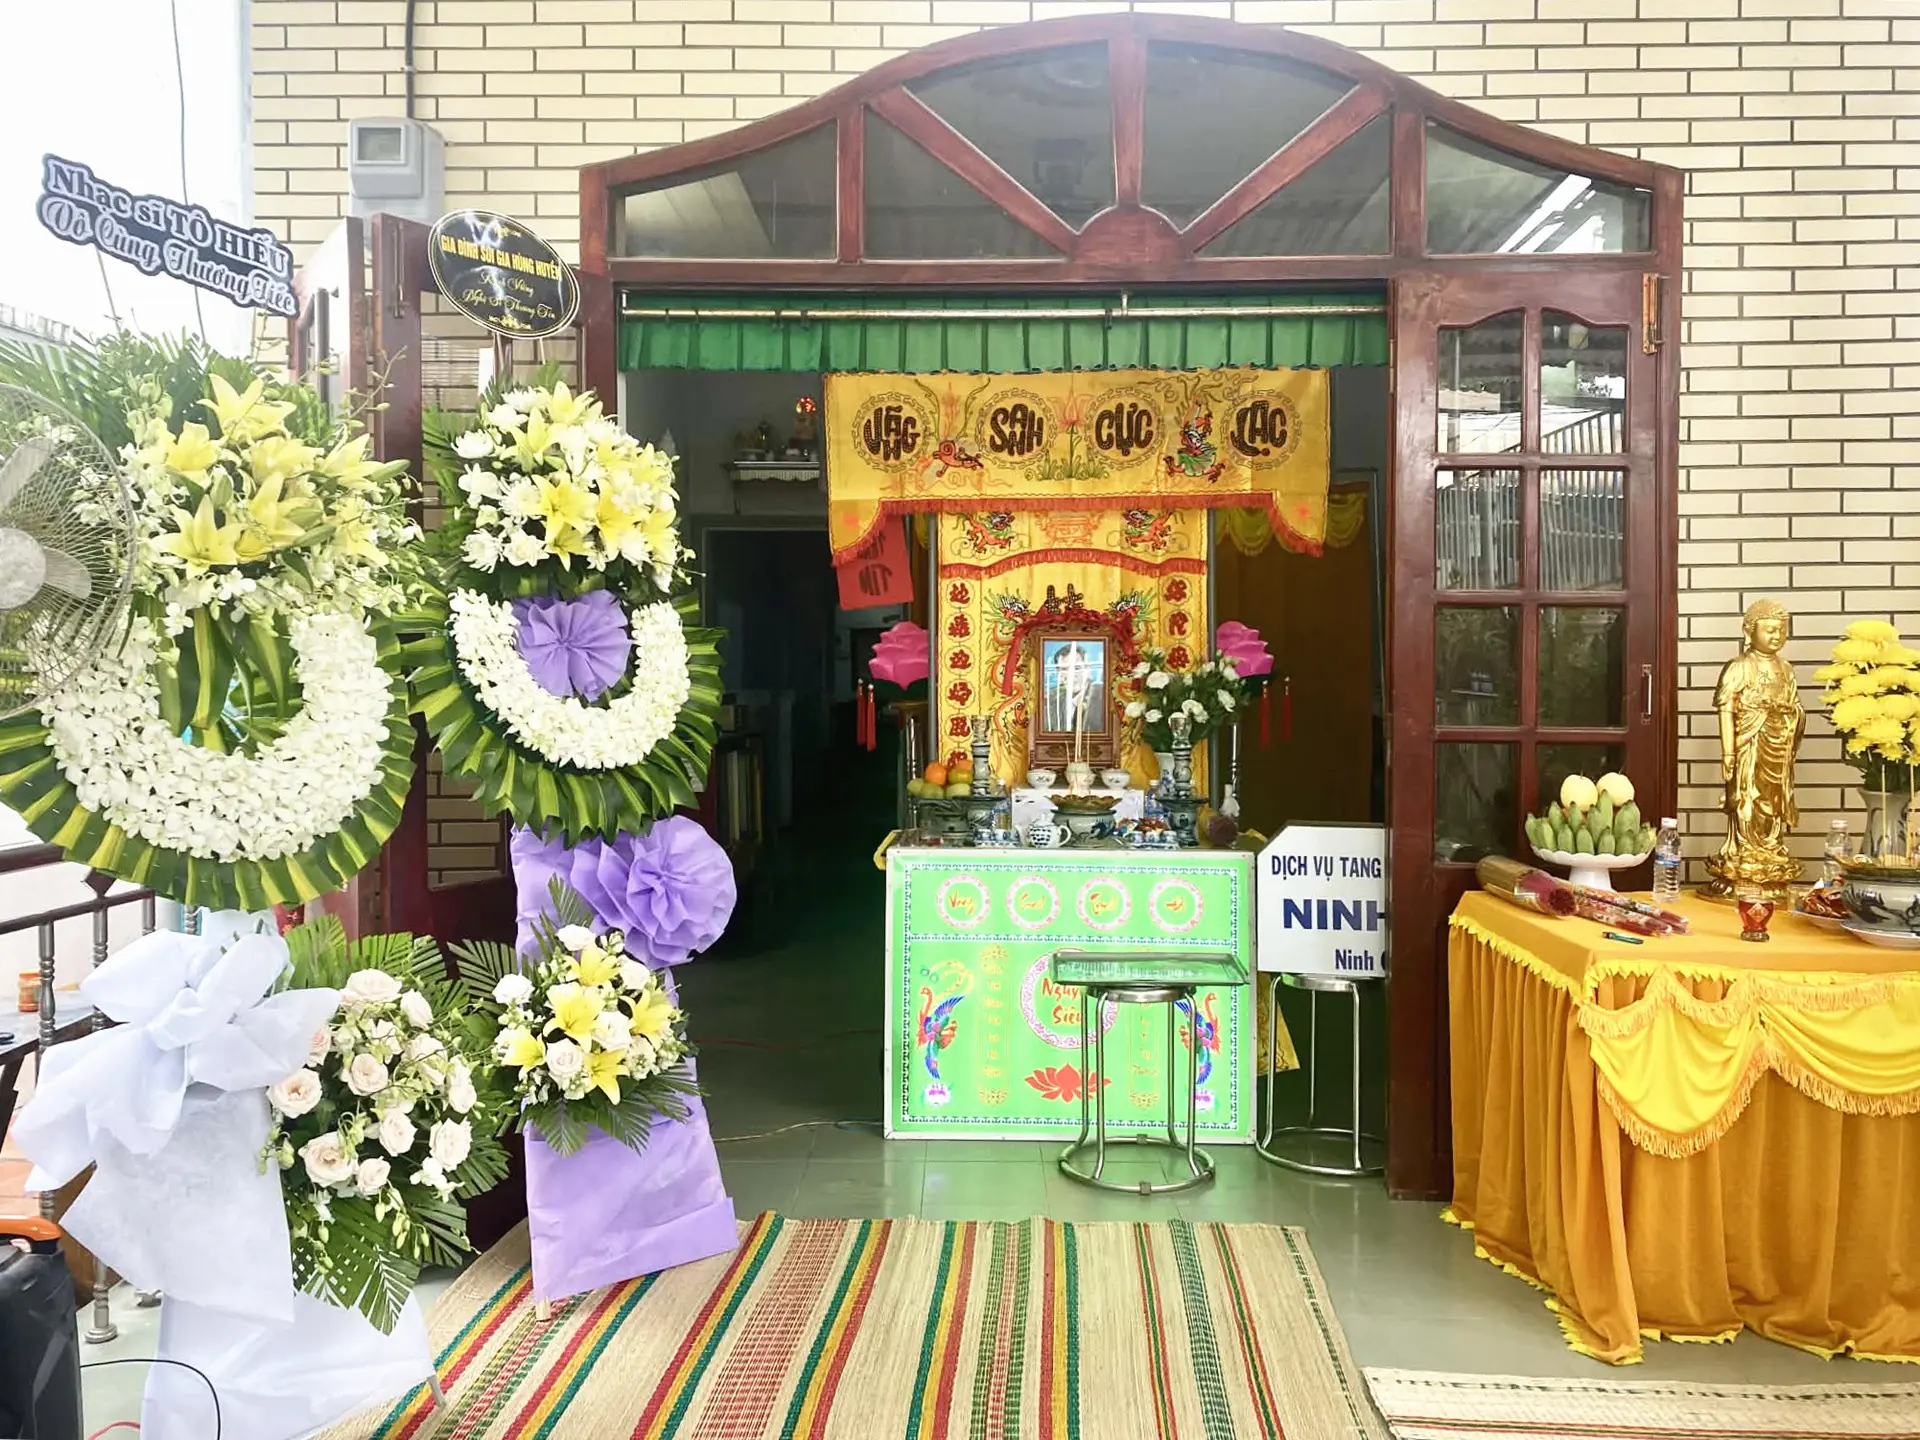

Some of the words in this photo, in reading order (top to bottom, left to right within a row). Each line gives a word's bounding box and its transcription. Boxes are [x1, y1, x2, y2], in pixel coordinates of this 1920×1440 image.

[50, 162, 129, 214] Nhạc
[138, 202, 163, 228] sĩ
[170, 209, 208, 243] TÔ
[46, 200, 90, 236] Vô
[98, 217, 159, 268] Cùng
[167, 242, 250, 302] Thương
[440, 234, 456, 254] GIA
[496, 249, 511, 269] GIA
[1094, 402, 1154, 457] CỰC
[1271, 855, 1308, 881] DỊCH
[1313, 856, 1334, 882] VỤ
[1340, 857, 1381, 879] TANG
[1335, 949, 1374, 971] Ninh
